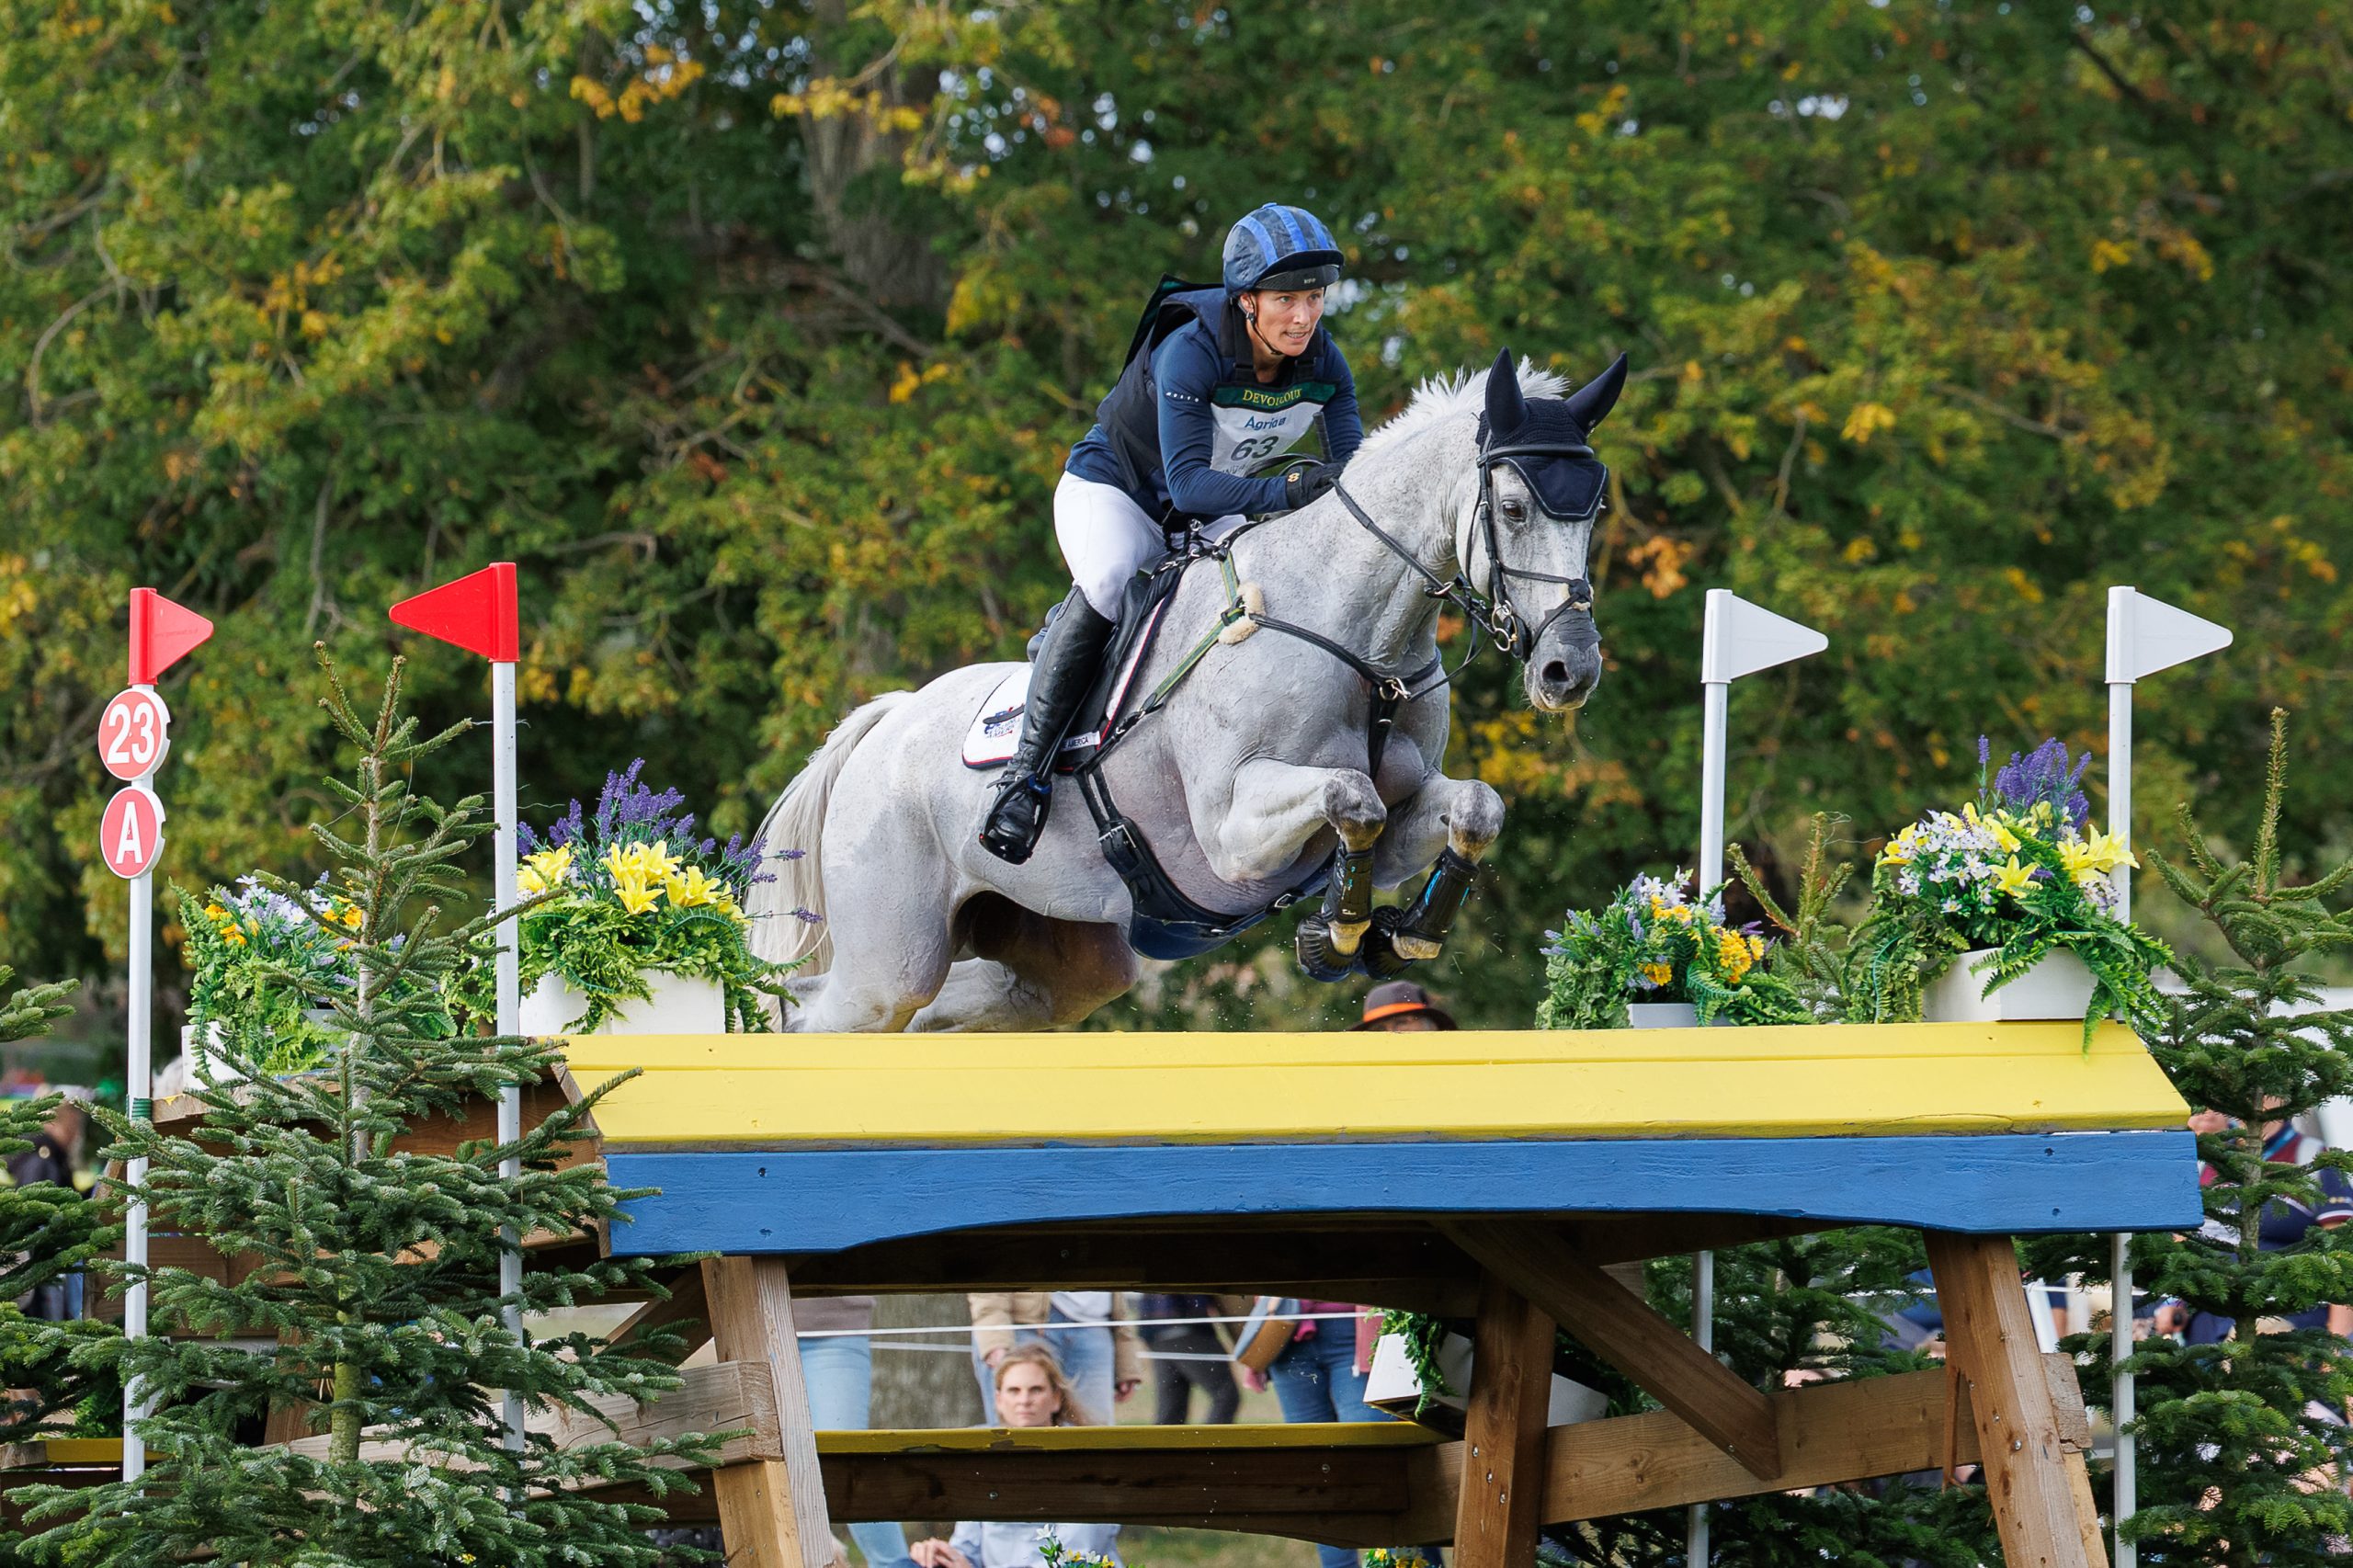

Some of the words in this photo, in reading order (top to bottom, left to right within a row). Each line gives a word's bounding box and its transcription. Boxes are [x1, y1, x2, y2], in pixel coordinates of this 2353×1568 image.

[1245, 415, 1279, 431] Agria
[1231, 435, 1279, 460] 63
[107, 701, 155, 765] 23
[115, 801, 143, 865] A
